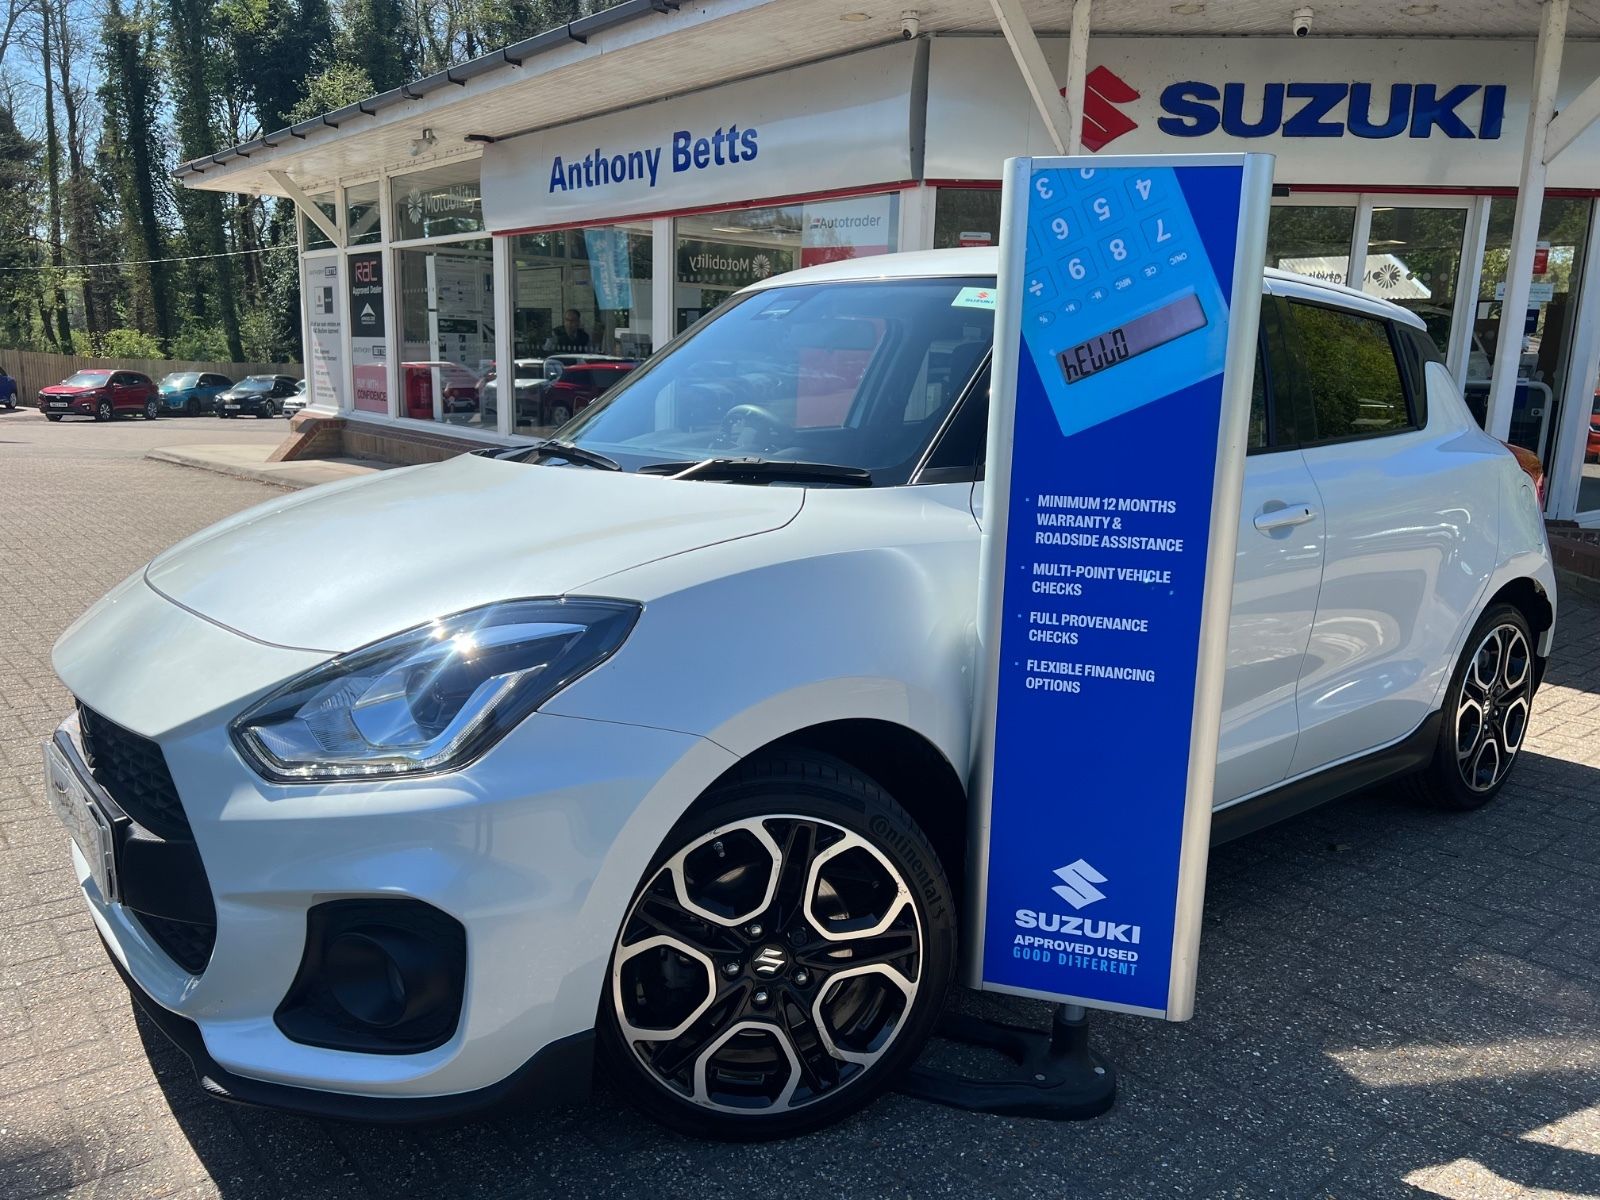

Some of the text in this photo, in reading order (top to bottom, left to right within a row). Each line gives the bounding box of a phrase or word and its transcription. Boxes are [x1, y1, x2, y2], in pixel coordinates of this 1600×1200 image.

[1157, 81, 1507, 139] SUZUKI
[549, 124, 758, 193] Anthony Betts
[1136, 179, 1151, 201] 4
[1093, 198, 1110, 221] 5
[819, 214, 881, 229] Autotrader
[1156, 219, 1172, 243] 7
[1109, 238, 1127, 261] 8
[1037, 494, 1177, 514] MINIMUM 12 MONTHS
[1036, 513, 1122, 530] WARRANTY &
[1035, 532, 1184, 552] ROADSIDE ASSISTANCE
[1033, 563, 1171, 584] MULTI-POINT VEHICLE
[1031, 581, 1082, 596] CHECKS
[1029, 611, 1148, 633] FULL PROVENANCE
[1028, 629, 1079, 645] CHECKS
[1026, 659, 1155, 683] FLEXIBLE FINANCING
[1026, 677, 1081, 694] OPTIONS
[1014, 909, 1141, 945] SUZUKI
[1013, 934, 1139, 962] APPROVED USED
[1012, 946, 1138, 976] GOOD DIFFERENT
